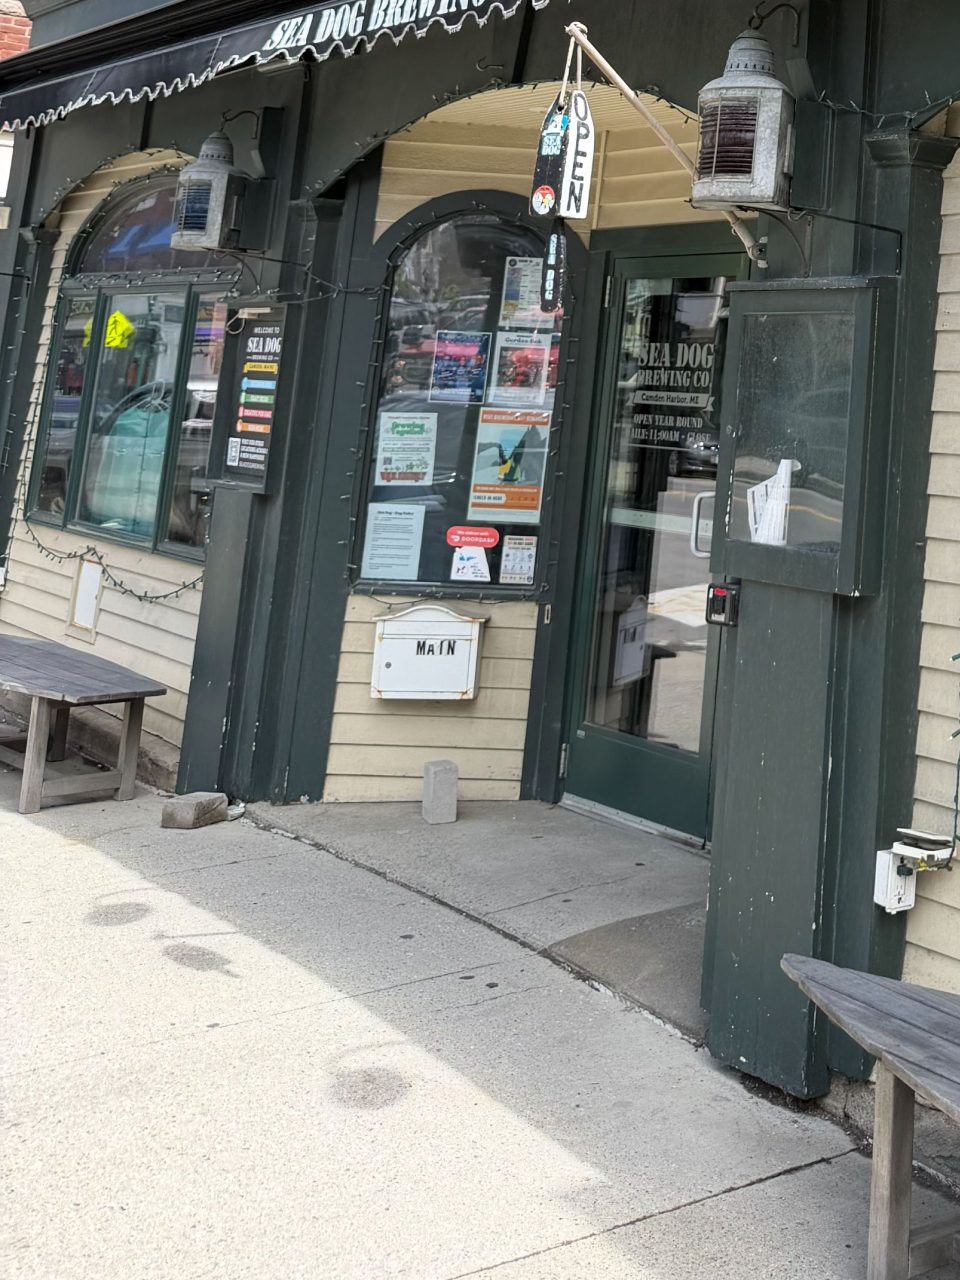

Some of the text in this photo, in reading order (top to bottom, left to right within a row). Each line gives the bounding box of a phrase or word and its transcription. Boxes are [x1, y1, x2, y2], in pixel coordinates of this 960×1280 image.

[262, 17, 311, 51] SEA
[543, 135, 562, 146] SEA
[541, 145, 561, 156] DOG
[566, 92, 591, 214] OPEN
[246, 337, 282, 353] SEA DOG
[638, 342, 715, 369] SEA DOG
[637, 369, 692, 387] BREWING
[641, 393, 665, 402] Camden
[690, 396, 700, 405] ME
[633, 413, 703, 429] OPEN YEAR ROUND
[629, 427, 649, 440] AILY:
